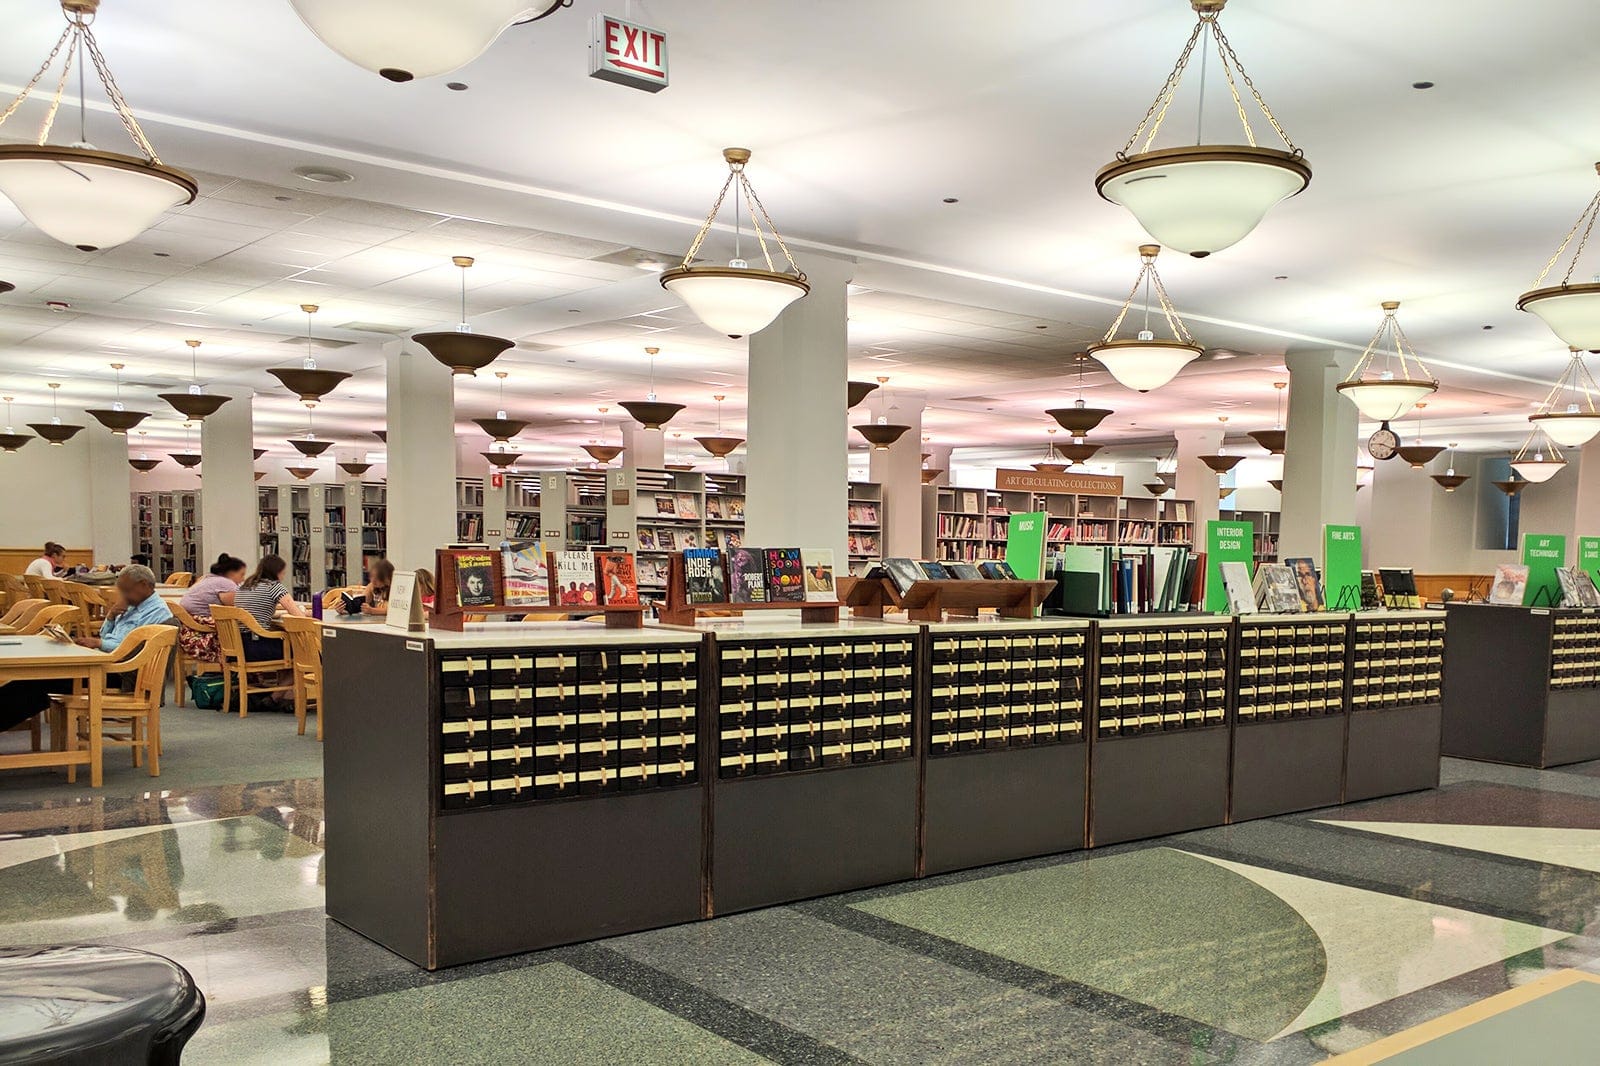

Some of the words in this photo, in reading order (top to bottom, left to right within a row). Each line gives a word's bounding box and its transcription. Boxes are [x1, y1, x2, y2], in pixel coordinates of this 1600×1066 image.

[605, 20, 664, 66] EXIT
[1005, 476, 1021, 485] ART
[1022, 477, 1070, 488] CIRCULATING
[1070, 479, 1117, 490] COLLECTIONS
[1019, 520, 1034, 531] MUSIC
[1216, 527, 1244, 537] INTERIOR
[1331, 531, 1342, 540] FINE
[1342, 531, 1356, 541] ARTS
[1219, 540, 1241, 550] DESIGN
[1539, 539, 1550, 547] ART
[563, 551, 590, 560] PLEASE
[686, 549, 719, 558] GIMME
[1529, 549, 1559, 558] TECHNIQUE
[581, 561, 594, 571] ME
[687, 557, 711, 568] INDIE
[770, 560, 800, 569] SOON
[688, 567, 712, 578] ROCK
[744, 572, 763, 581] ROBERT
[771, 568, 781, 576] IS
[747, 580, 763, 589] PLANT
[771, 575, 801, 585] NOW
